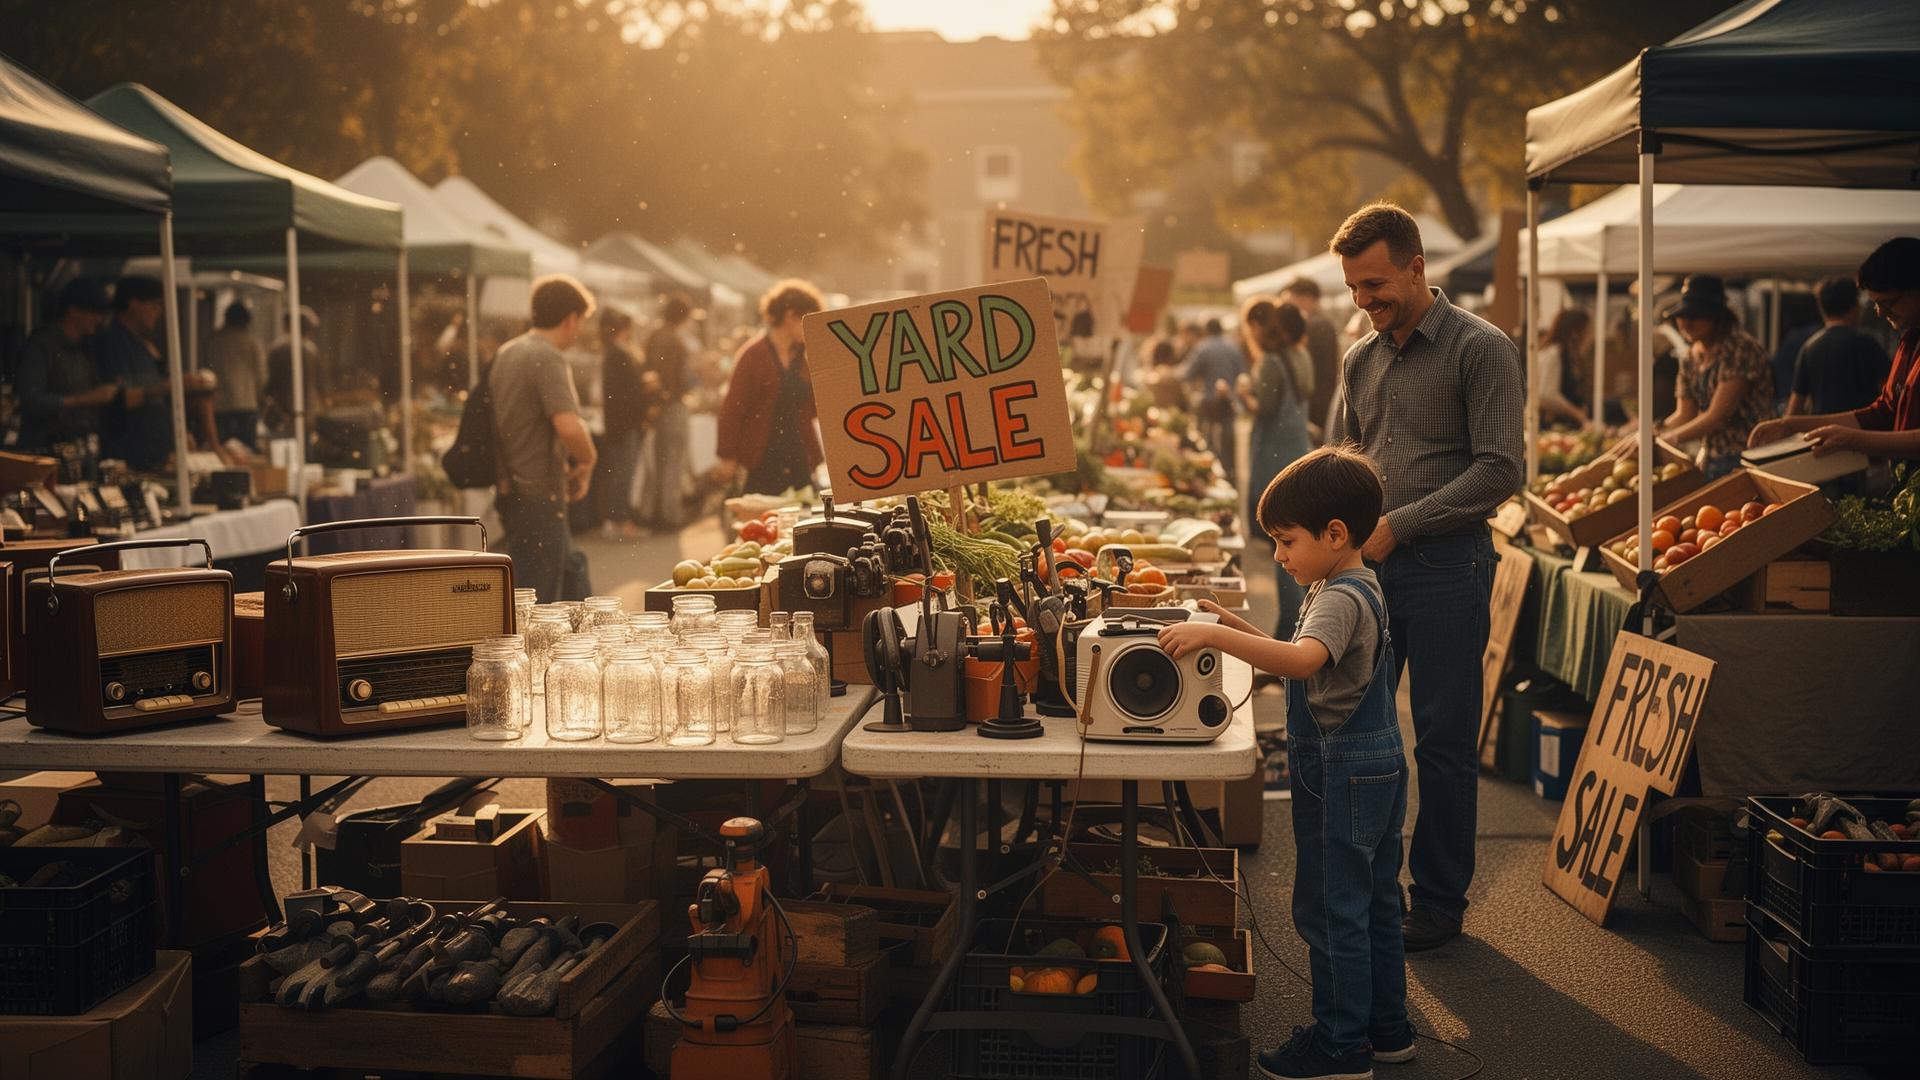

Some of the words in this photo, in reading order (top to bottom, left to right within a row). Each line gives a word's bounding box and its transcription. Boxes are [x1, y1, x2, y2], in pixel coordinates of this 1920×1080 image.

[992, 219, 1099, 277] FRESH
[827, 295, 1035, 395] YARD
[844, 381, 1045, 489] SALE
[1597, 652, 1706, 781] FRESH
[1556, 770, 1639, 898] SALE
